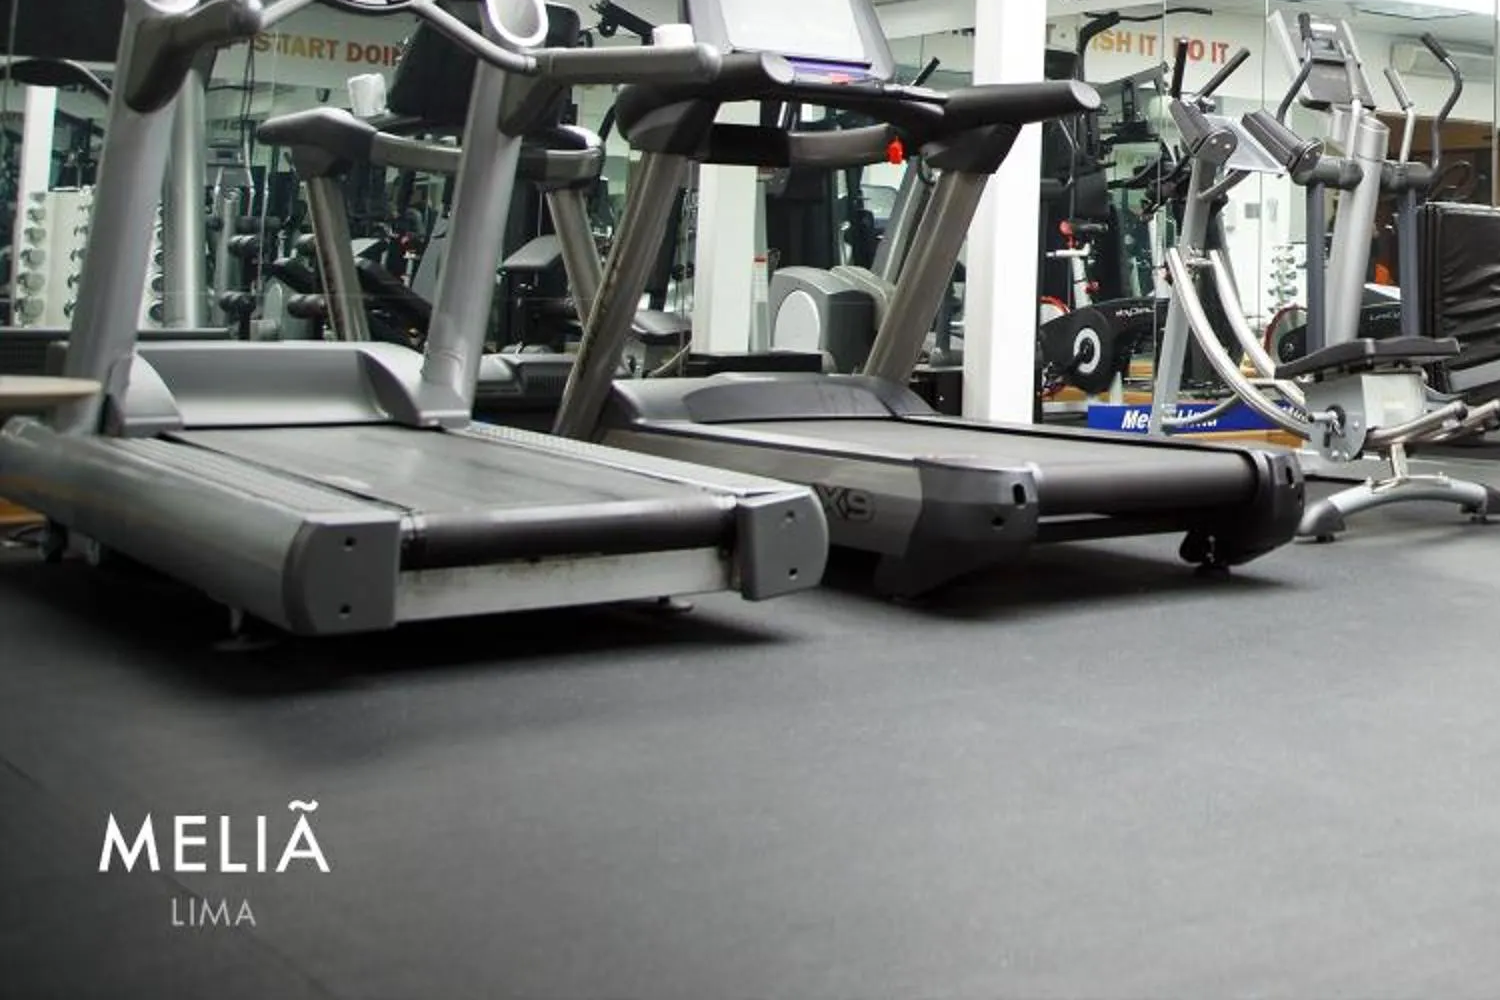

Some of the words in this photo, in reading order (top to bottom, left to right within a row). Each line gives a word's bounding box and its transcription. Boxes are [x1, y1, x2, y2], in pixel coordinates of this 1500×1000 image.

[254, 33, 340, 60] START
[346, 42, 402, 67] DOI
[1091, 30, 1132, 53] ISH
